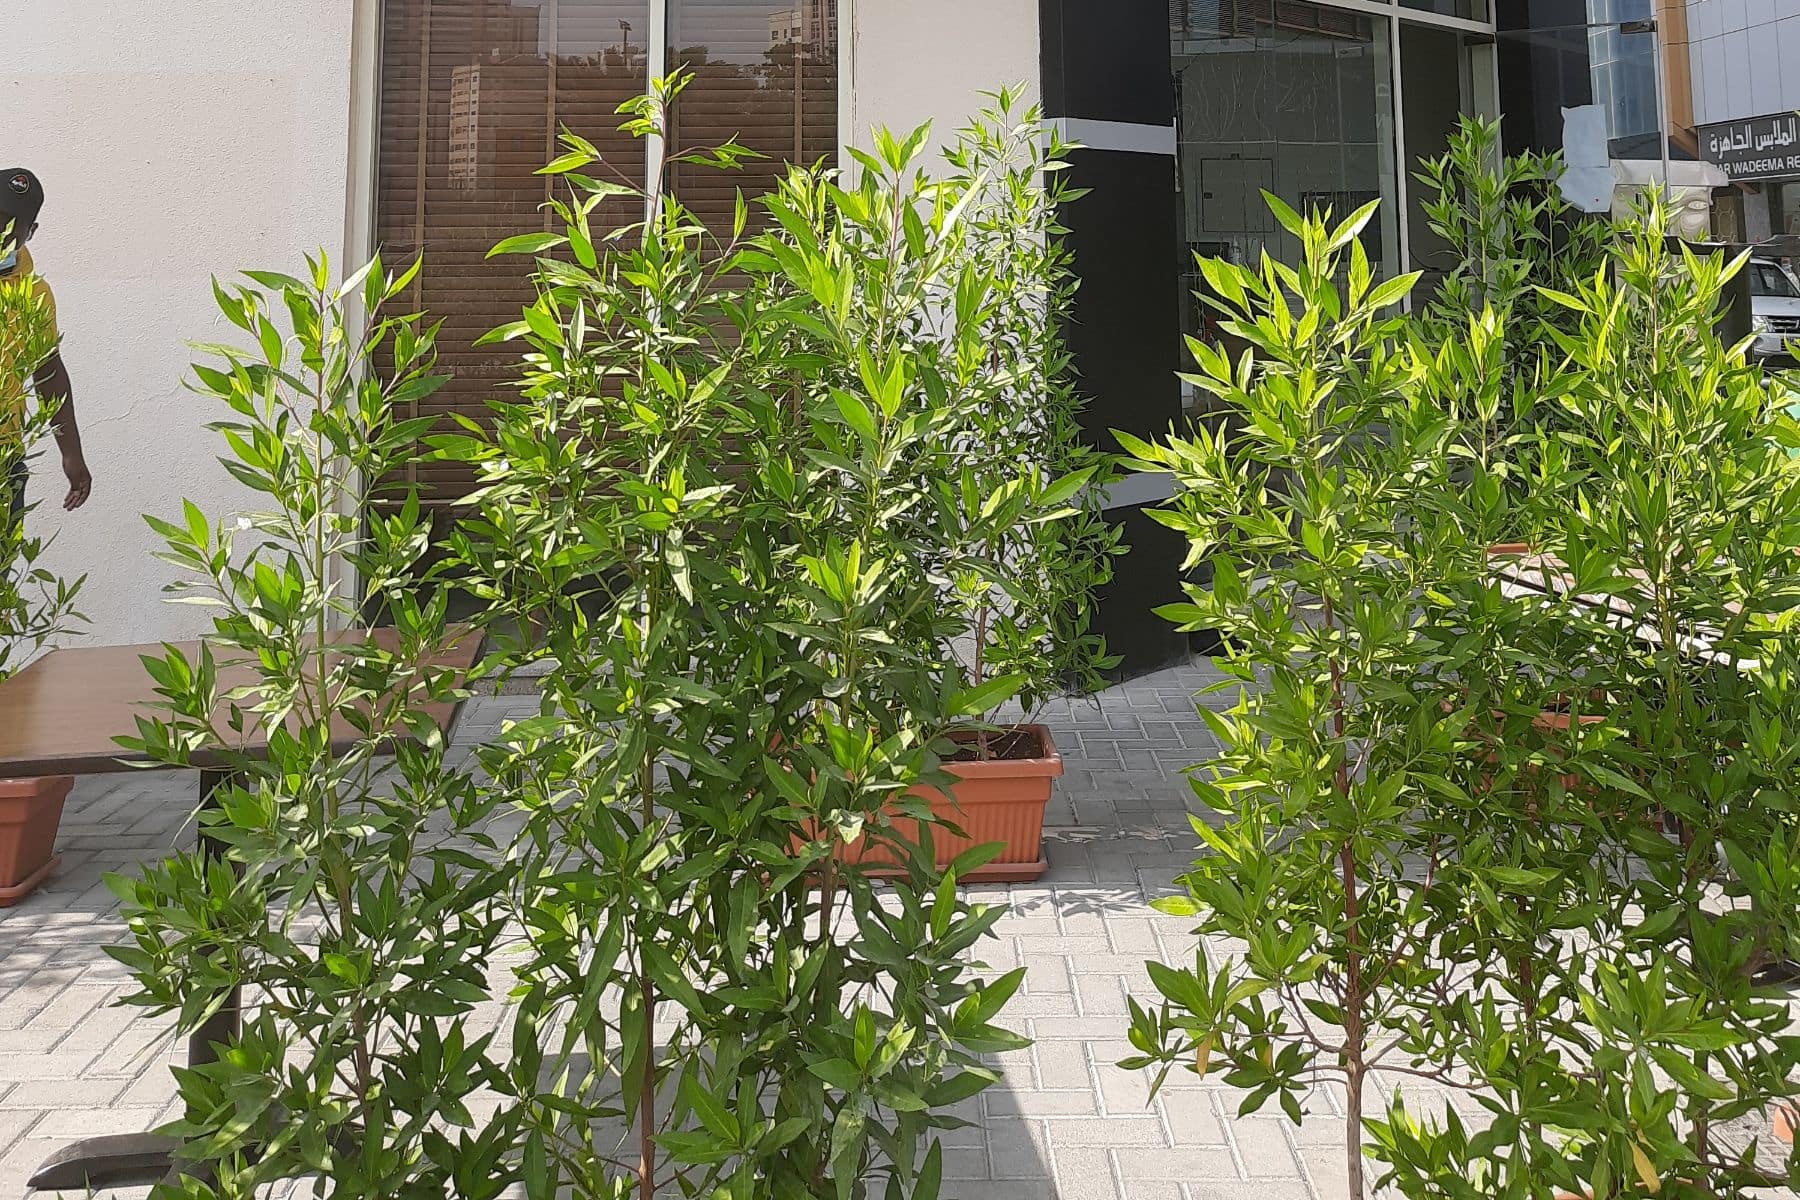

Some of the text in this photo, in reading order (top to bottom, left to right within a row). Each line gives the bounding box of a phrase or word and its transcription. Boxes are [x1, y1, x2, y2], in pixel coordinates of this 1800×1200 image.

[1710, 117, 1796, 159] الملابس الجاهزة
[1733, 158, 1784, 174] WADEEMA
